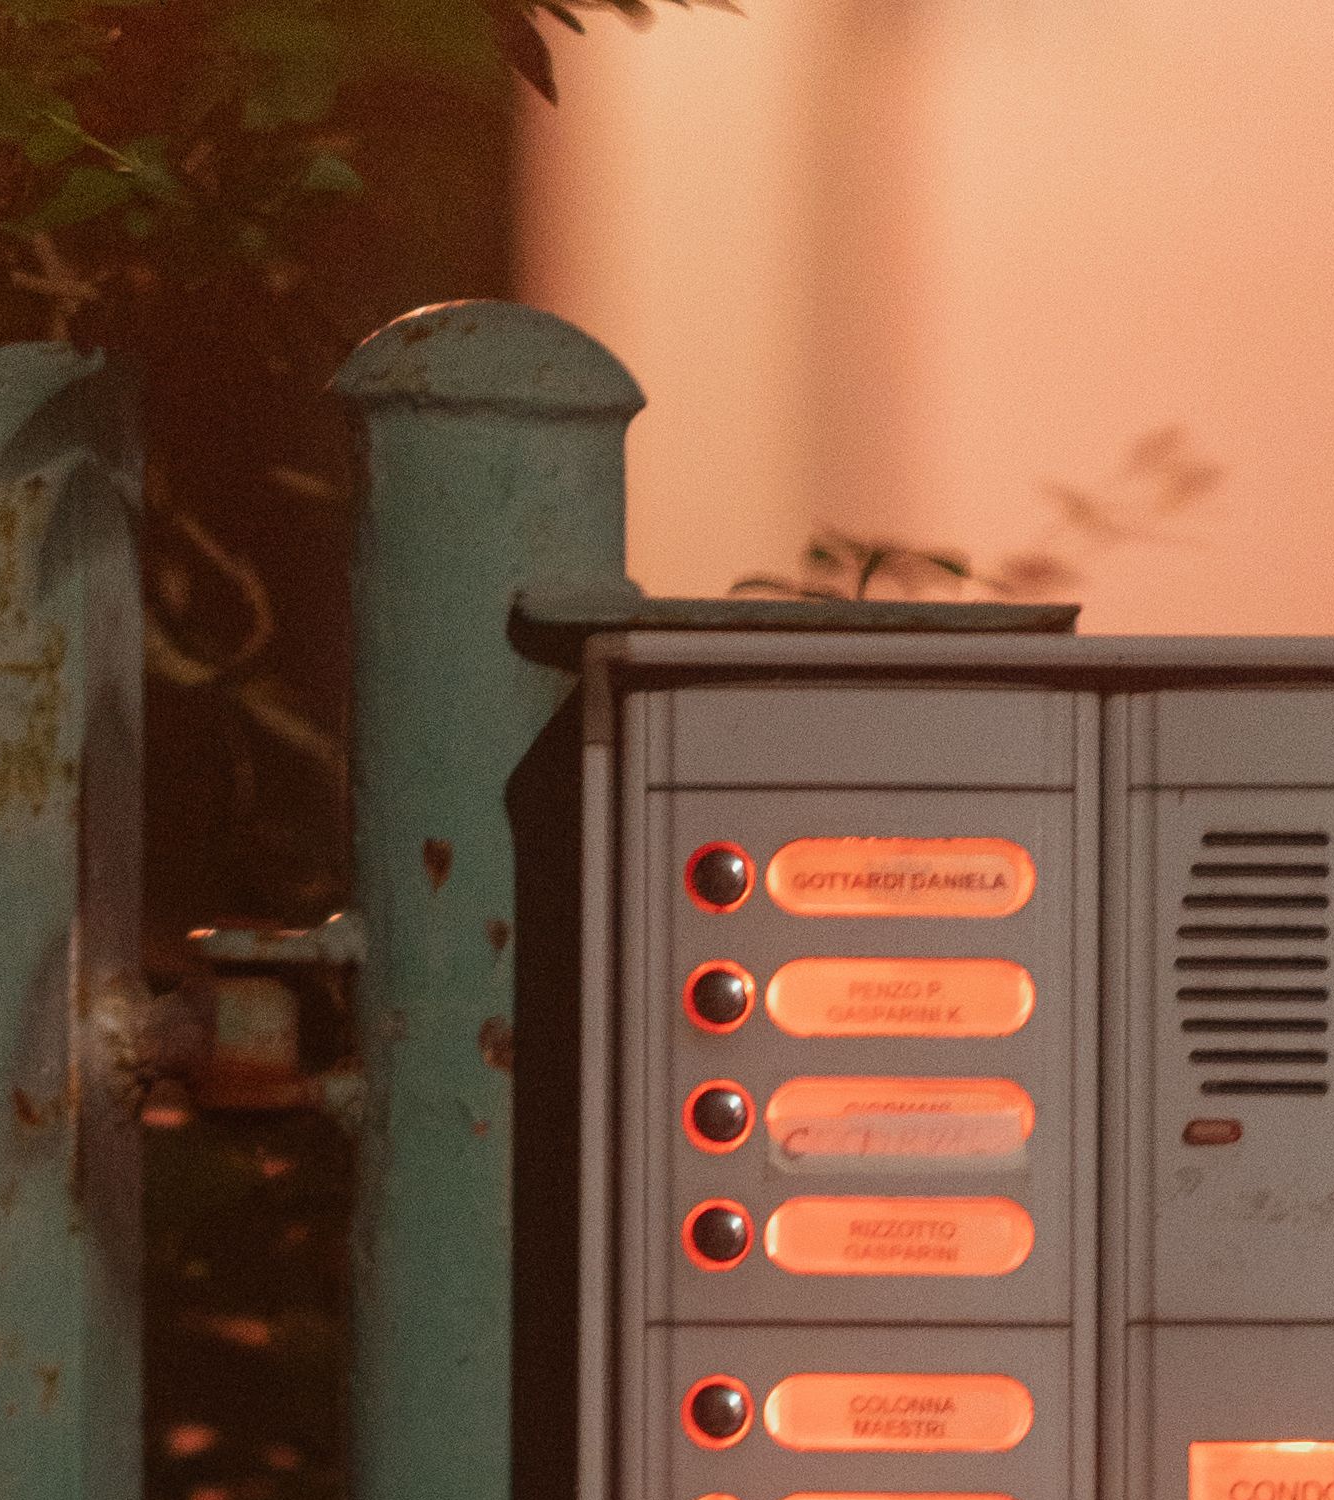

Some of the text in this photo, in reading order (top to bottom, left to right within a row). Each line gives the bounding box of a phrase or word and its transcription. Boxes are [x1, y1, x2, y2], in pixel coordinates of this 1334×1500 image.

[792, 872, 1007, 891] GOTTARDI DANIELA
[849, 1219, 958, 1239] RIZZOTTO
[849, 1395, 956, 1414] COLONNA
[852, 1419, 946, 1438] MAESTRI
